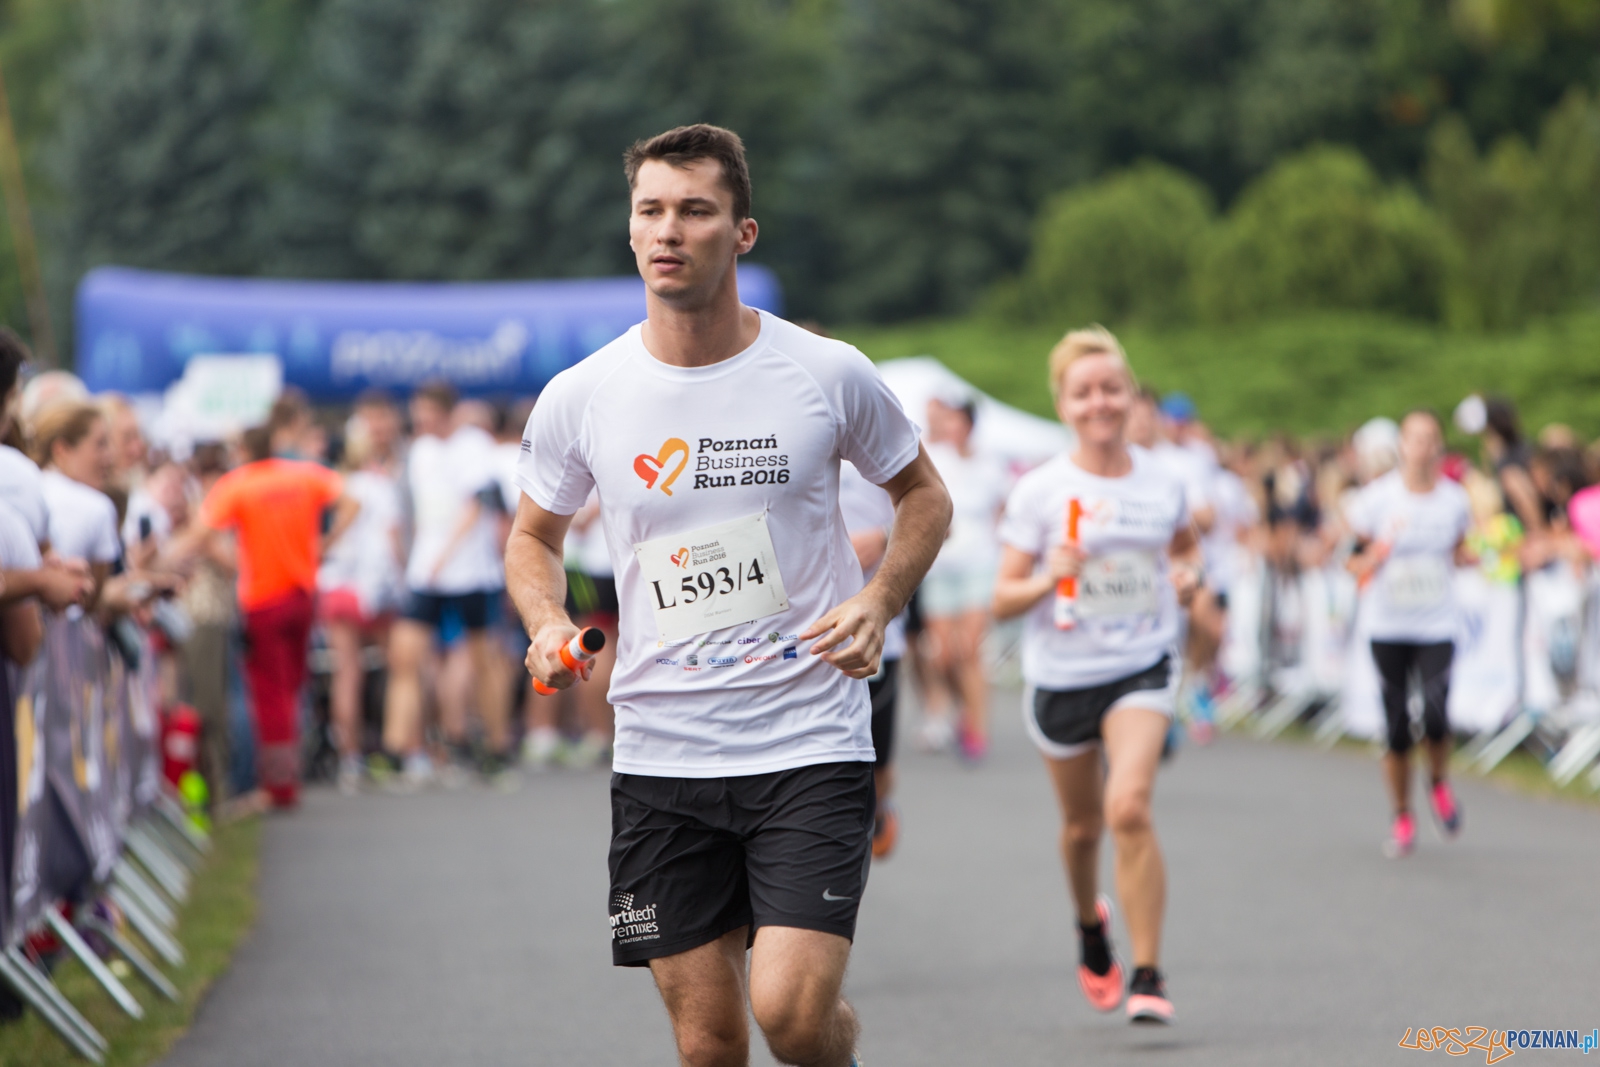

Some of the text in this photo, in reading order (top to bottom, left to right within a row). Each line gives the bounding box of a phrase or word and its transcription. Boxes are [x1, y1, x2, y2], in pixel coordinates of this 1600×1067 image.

[697, 434, 778, 453] Poznań
[695, 453, 789, 472] Business
[693, 469, 791, 490] Run 2016
[691, 539, 720, 553] Poznań
[692, 546, 725, 560] Business
[692, 551, 727, 566] Run 2016
[651, 579, 677, 610] L
[681, 557, 764, 604] 593/4
[737, 636, 761, 645] ciber
